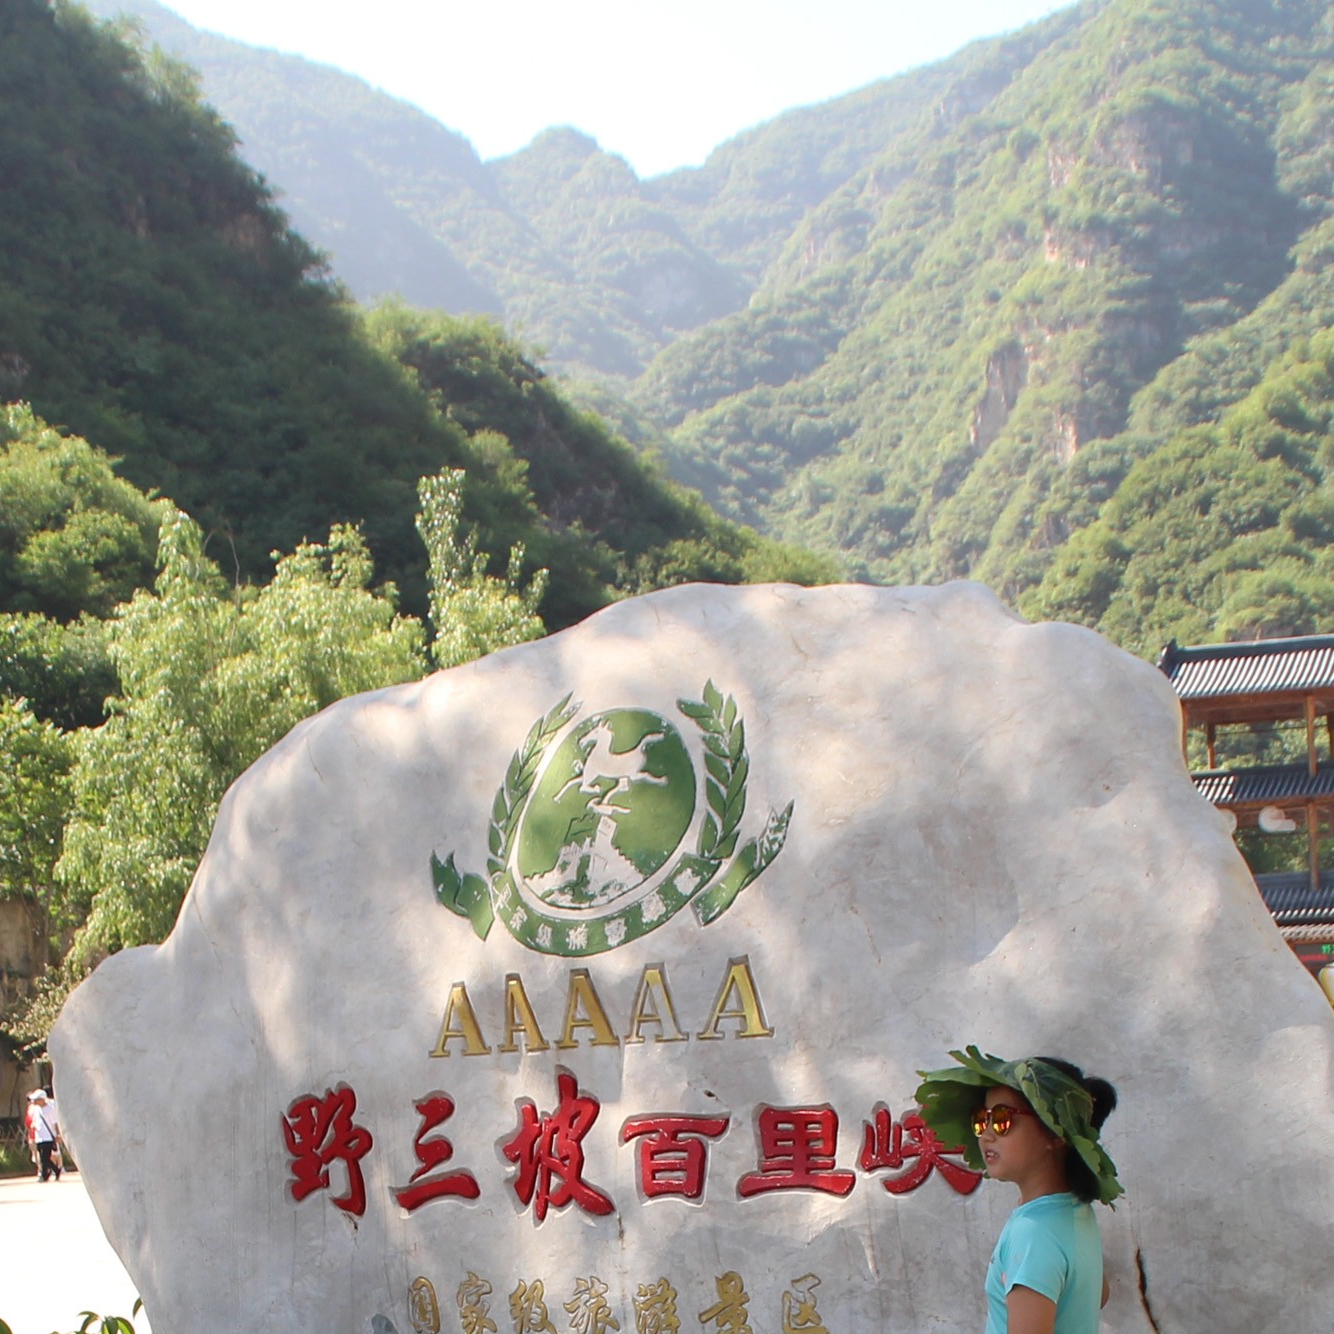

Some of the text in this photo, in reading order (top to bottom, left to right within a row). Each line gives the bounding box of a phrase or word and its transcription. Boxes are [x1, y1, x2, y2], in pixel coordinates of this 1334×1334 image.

[428, 954, 775, 1058] AAAAA
[281, 1070, 983, 1222] 野三坡百里峡
